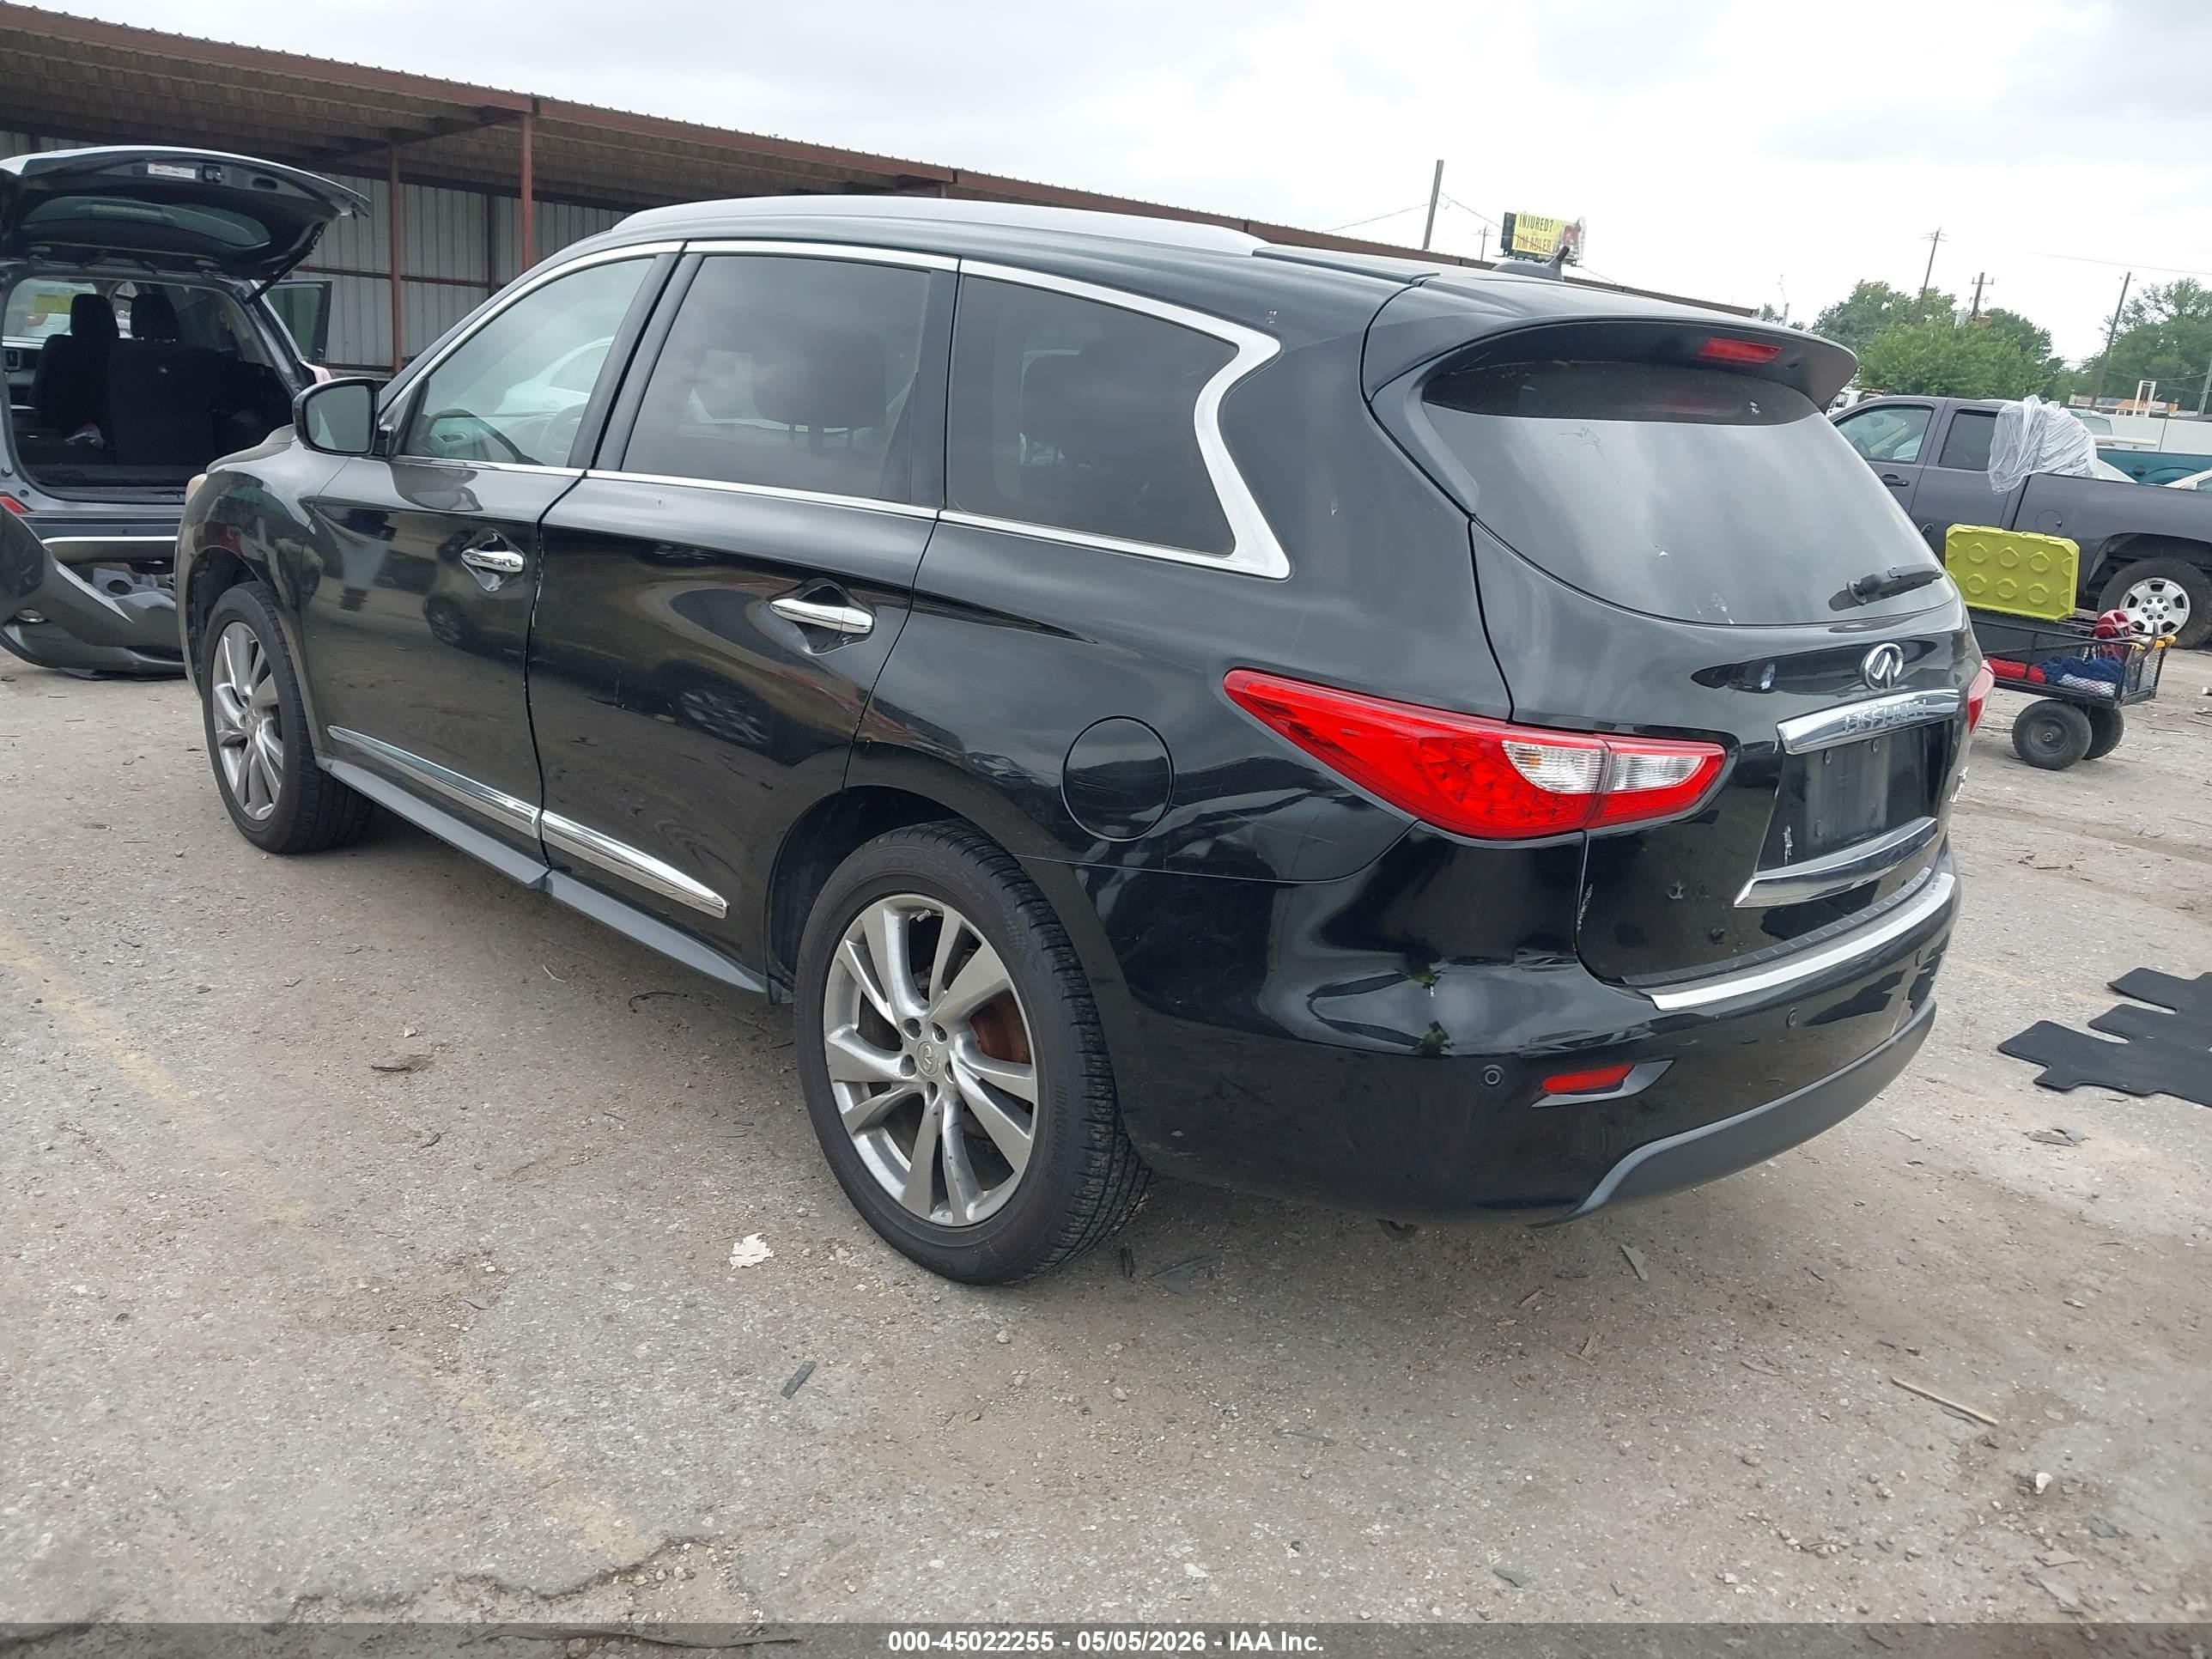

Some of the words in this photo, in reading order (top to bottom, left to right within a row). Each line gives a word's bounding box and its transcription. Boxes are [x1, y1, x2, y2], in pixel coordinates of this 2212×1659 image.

[1518, 214, 1553, 233] INJURED?
[1516, 234, 1528, 248] JIM
[1528, 236, 1552, 252] ADLER
